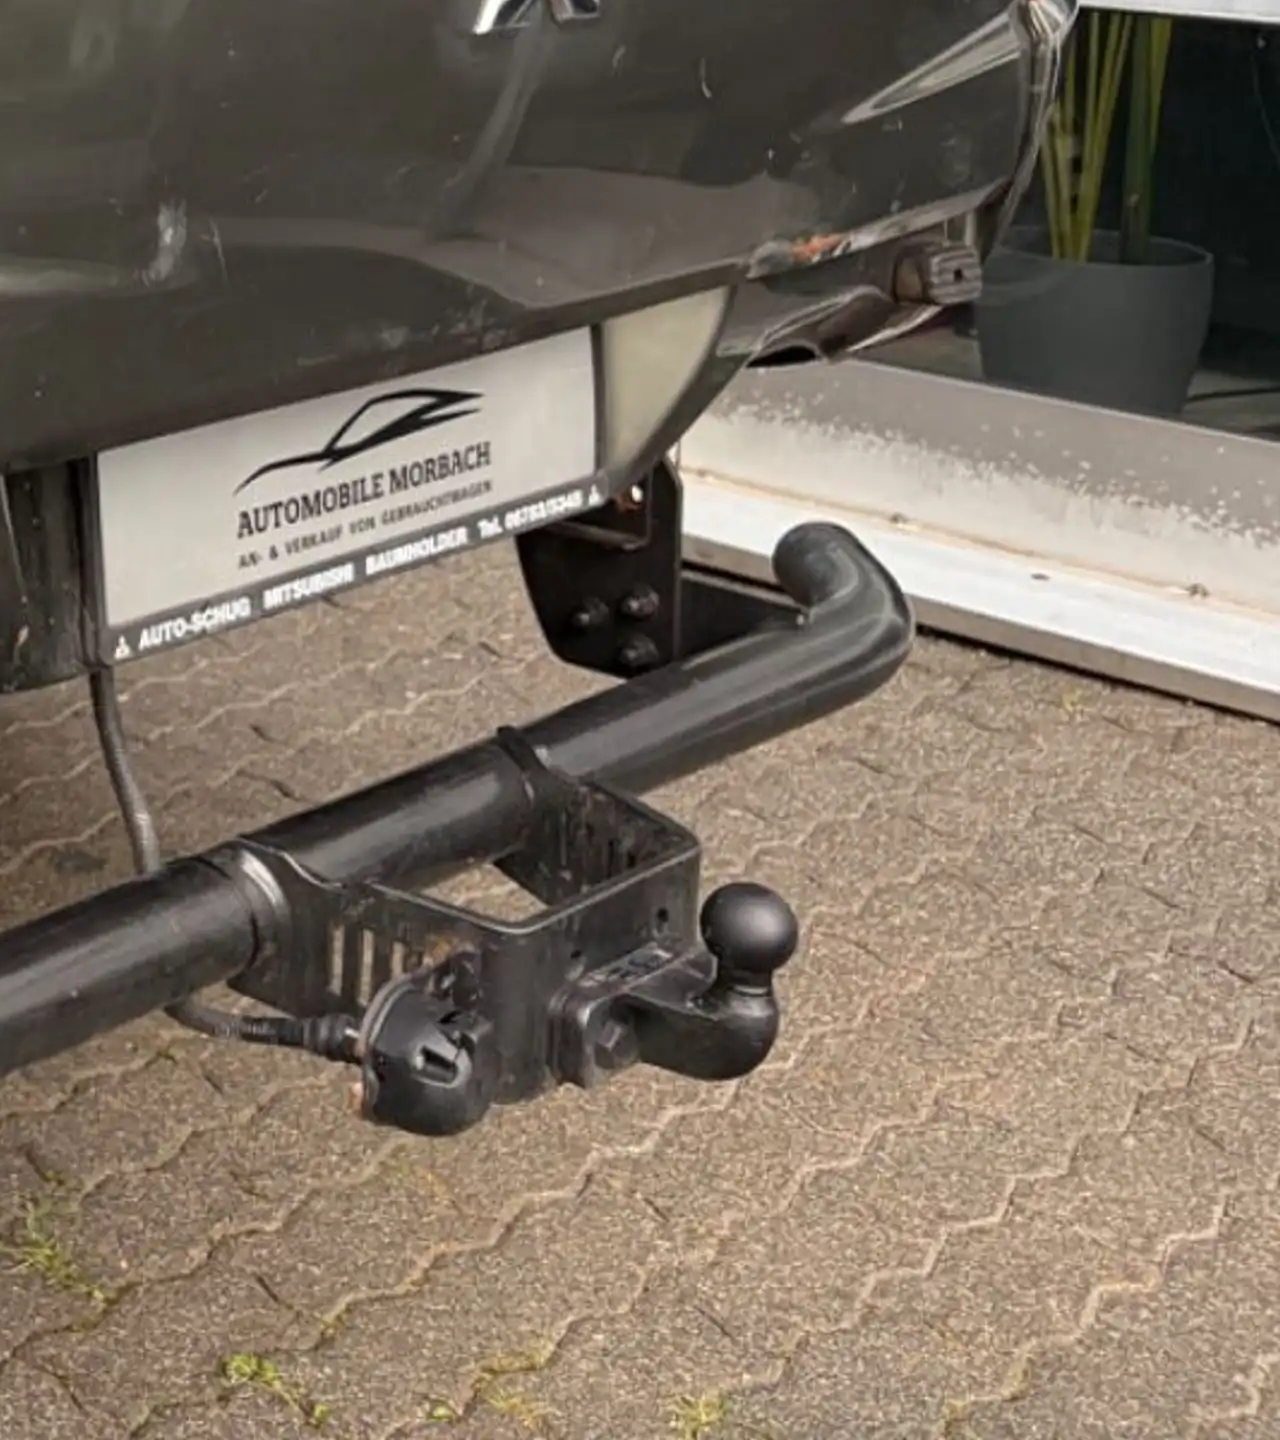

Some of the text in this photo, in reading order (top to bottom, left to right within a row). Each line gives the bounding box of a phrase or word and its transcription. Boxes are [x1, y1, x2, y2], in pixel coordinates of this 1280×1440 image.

[237, 441, 492, 540] AUTOMOBILE MORBACH
[263, 563, 355, 610] MITSUBISHI
[365, 526, 469, 576] BAUMHOLDER
[285, 525, 344, 556] VERKAUF
[349, 514, 377, 536] VON
